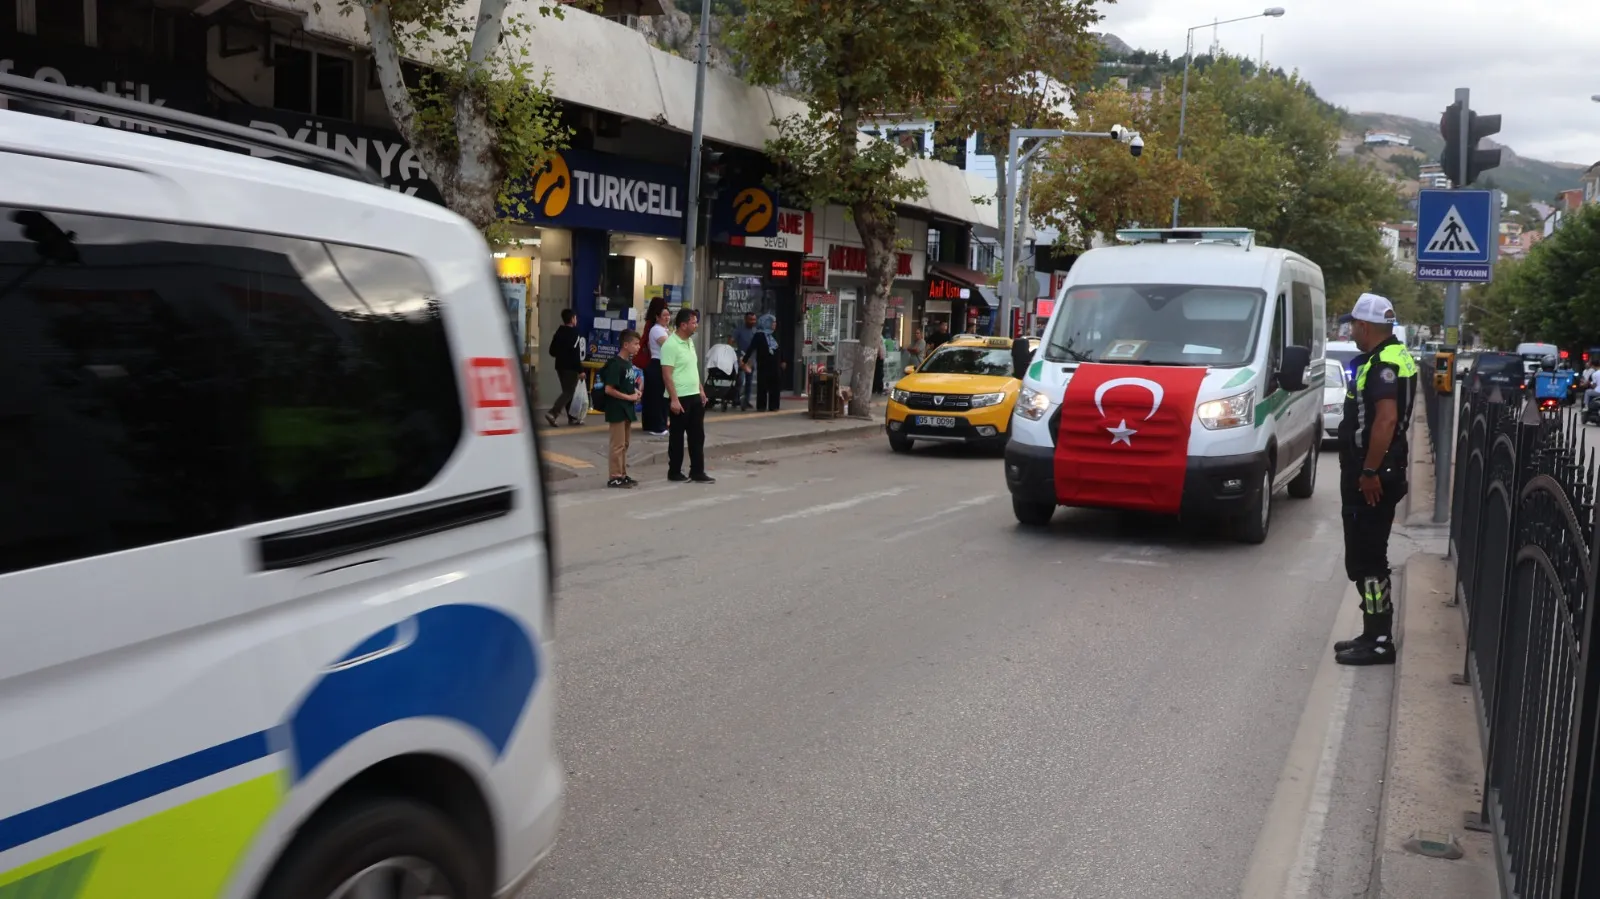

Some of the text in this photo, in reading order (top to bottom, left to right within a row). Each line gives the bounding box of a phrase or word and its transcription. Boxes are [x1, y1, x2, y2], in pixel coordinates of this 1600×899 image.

[572, 169, 682, 218] TURKCELL
[778, 211, 803, 235] ANE
[764, 236, 788, 249] SEVEN
[1420, 266, 1488, 278] ÖNCELİK YAYANIN
